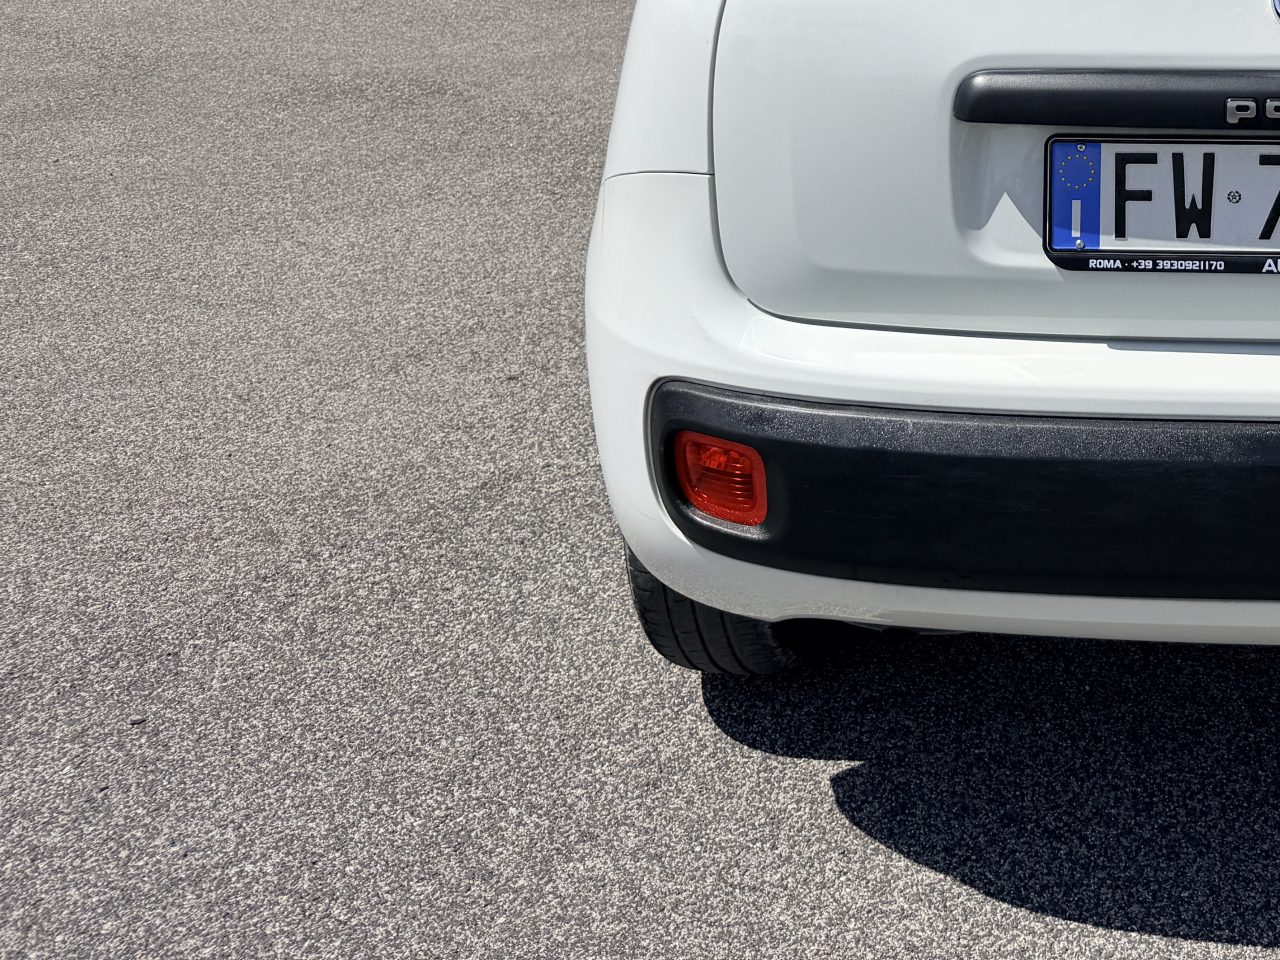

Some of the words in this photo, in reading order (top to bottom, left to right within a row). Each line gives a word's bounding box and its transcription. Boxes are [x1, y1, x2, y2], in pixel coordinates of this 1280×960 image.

[1114, 152, 1215, 239] FW
[1089, 259, 1122, 269] ROMA
[1131, 260, 1153, 269] +39
[1156, 260, 1224, 270] 3930921170
